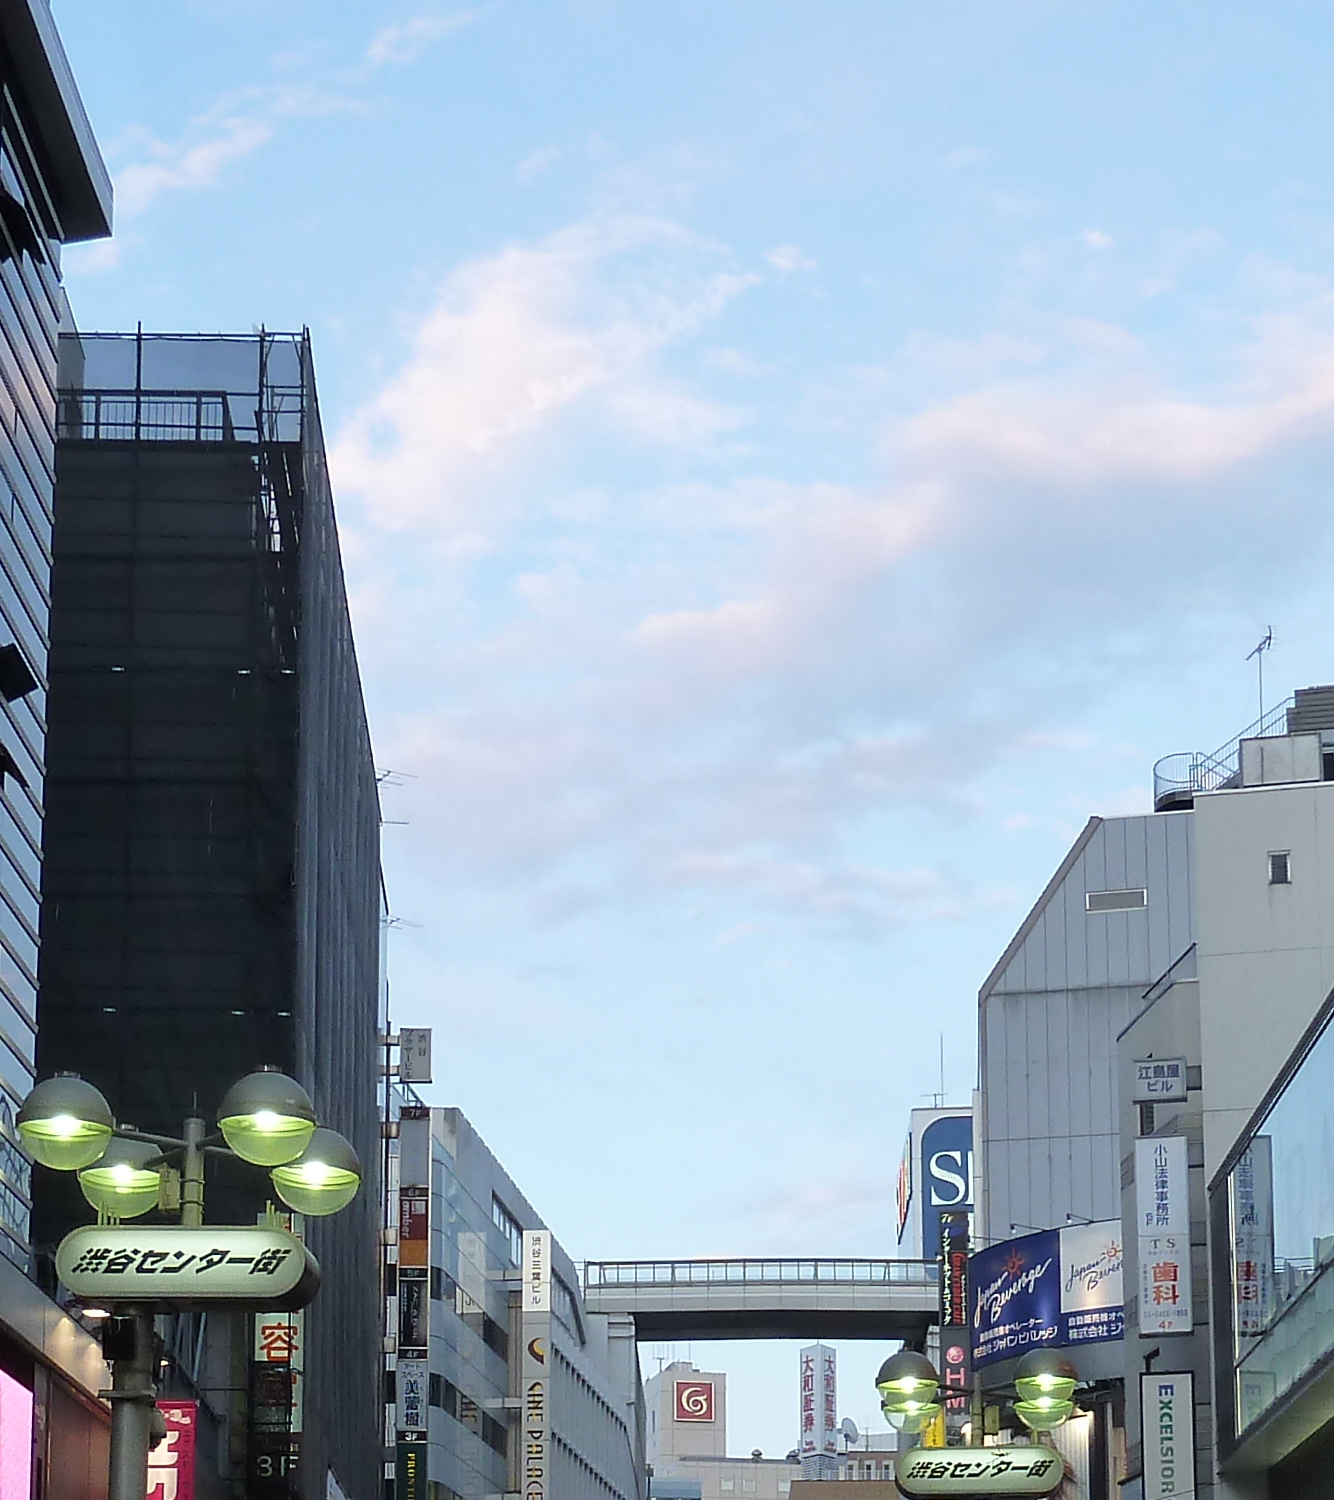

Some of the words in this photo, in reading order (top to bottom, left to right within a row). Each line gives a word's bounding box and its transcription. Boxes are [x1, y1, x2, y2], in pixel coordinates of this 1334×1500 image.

[1147, 1081, 1172, 1092] ビル
[1155, 1144, 1170, 1227] 小山法律事務所
[72, 1247, 292, 1276] 渋谷センター街
[1151, 1261, 1180, 1306] 歯科
[1068, 1326, 1107, 1340] 株式会社
[802, 1355, 815, 1433] 大和証券
[406, 1430, 419, 1441] 3F
[1159, 1384, 1175, 1493] EXCELSIOR
[257, 1457, 299, 1477] 3F
[907, 1460, 1053, 1480] 渋谷センター街
